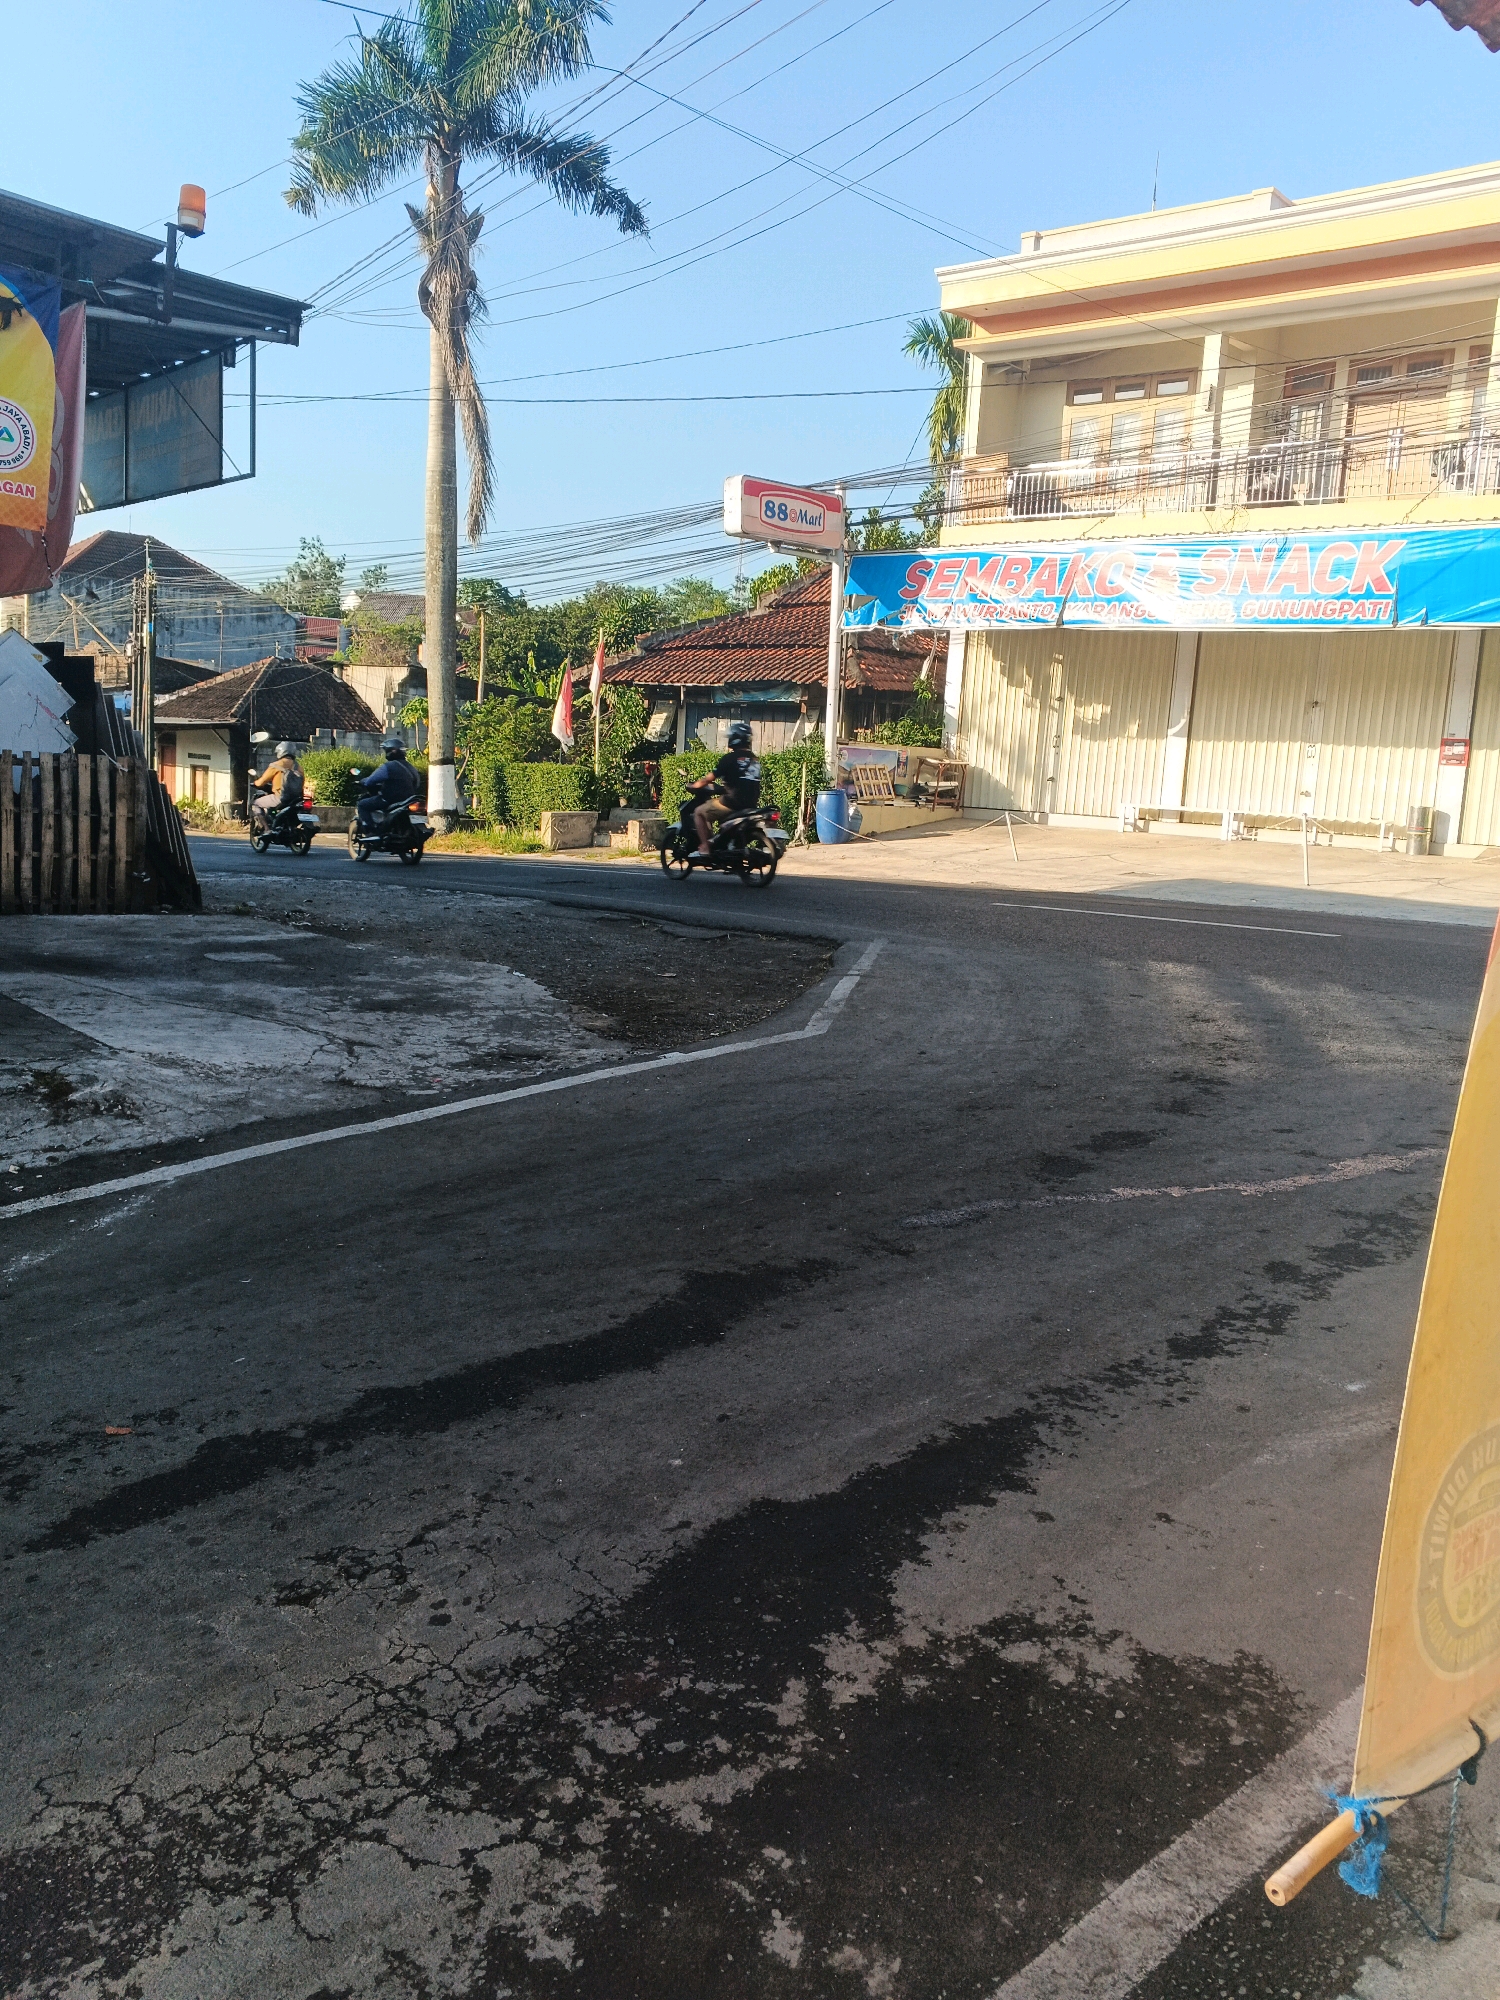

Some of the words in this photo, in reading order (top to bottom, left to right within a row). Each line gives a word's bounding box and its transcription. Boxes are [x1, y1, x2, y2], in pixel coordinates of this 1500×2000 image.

[3, 405, 23, 424] JAYA
[20, 423, 31, 450] ABADI
[0, 481, 35, 498] GAN
[764, 499, 788, 522] 88
[796, 508, 823, 527] Mart
[898, 552, 1137, 601] SEMBAKO
[1191, 541, 1407, 596] SNACK
[1242, 599, 1392, 620] GUNUNGPATI
